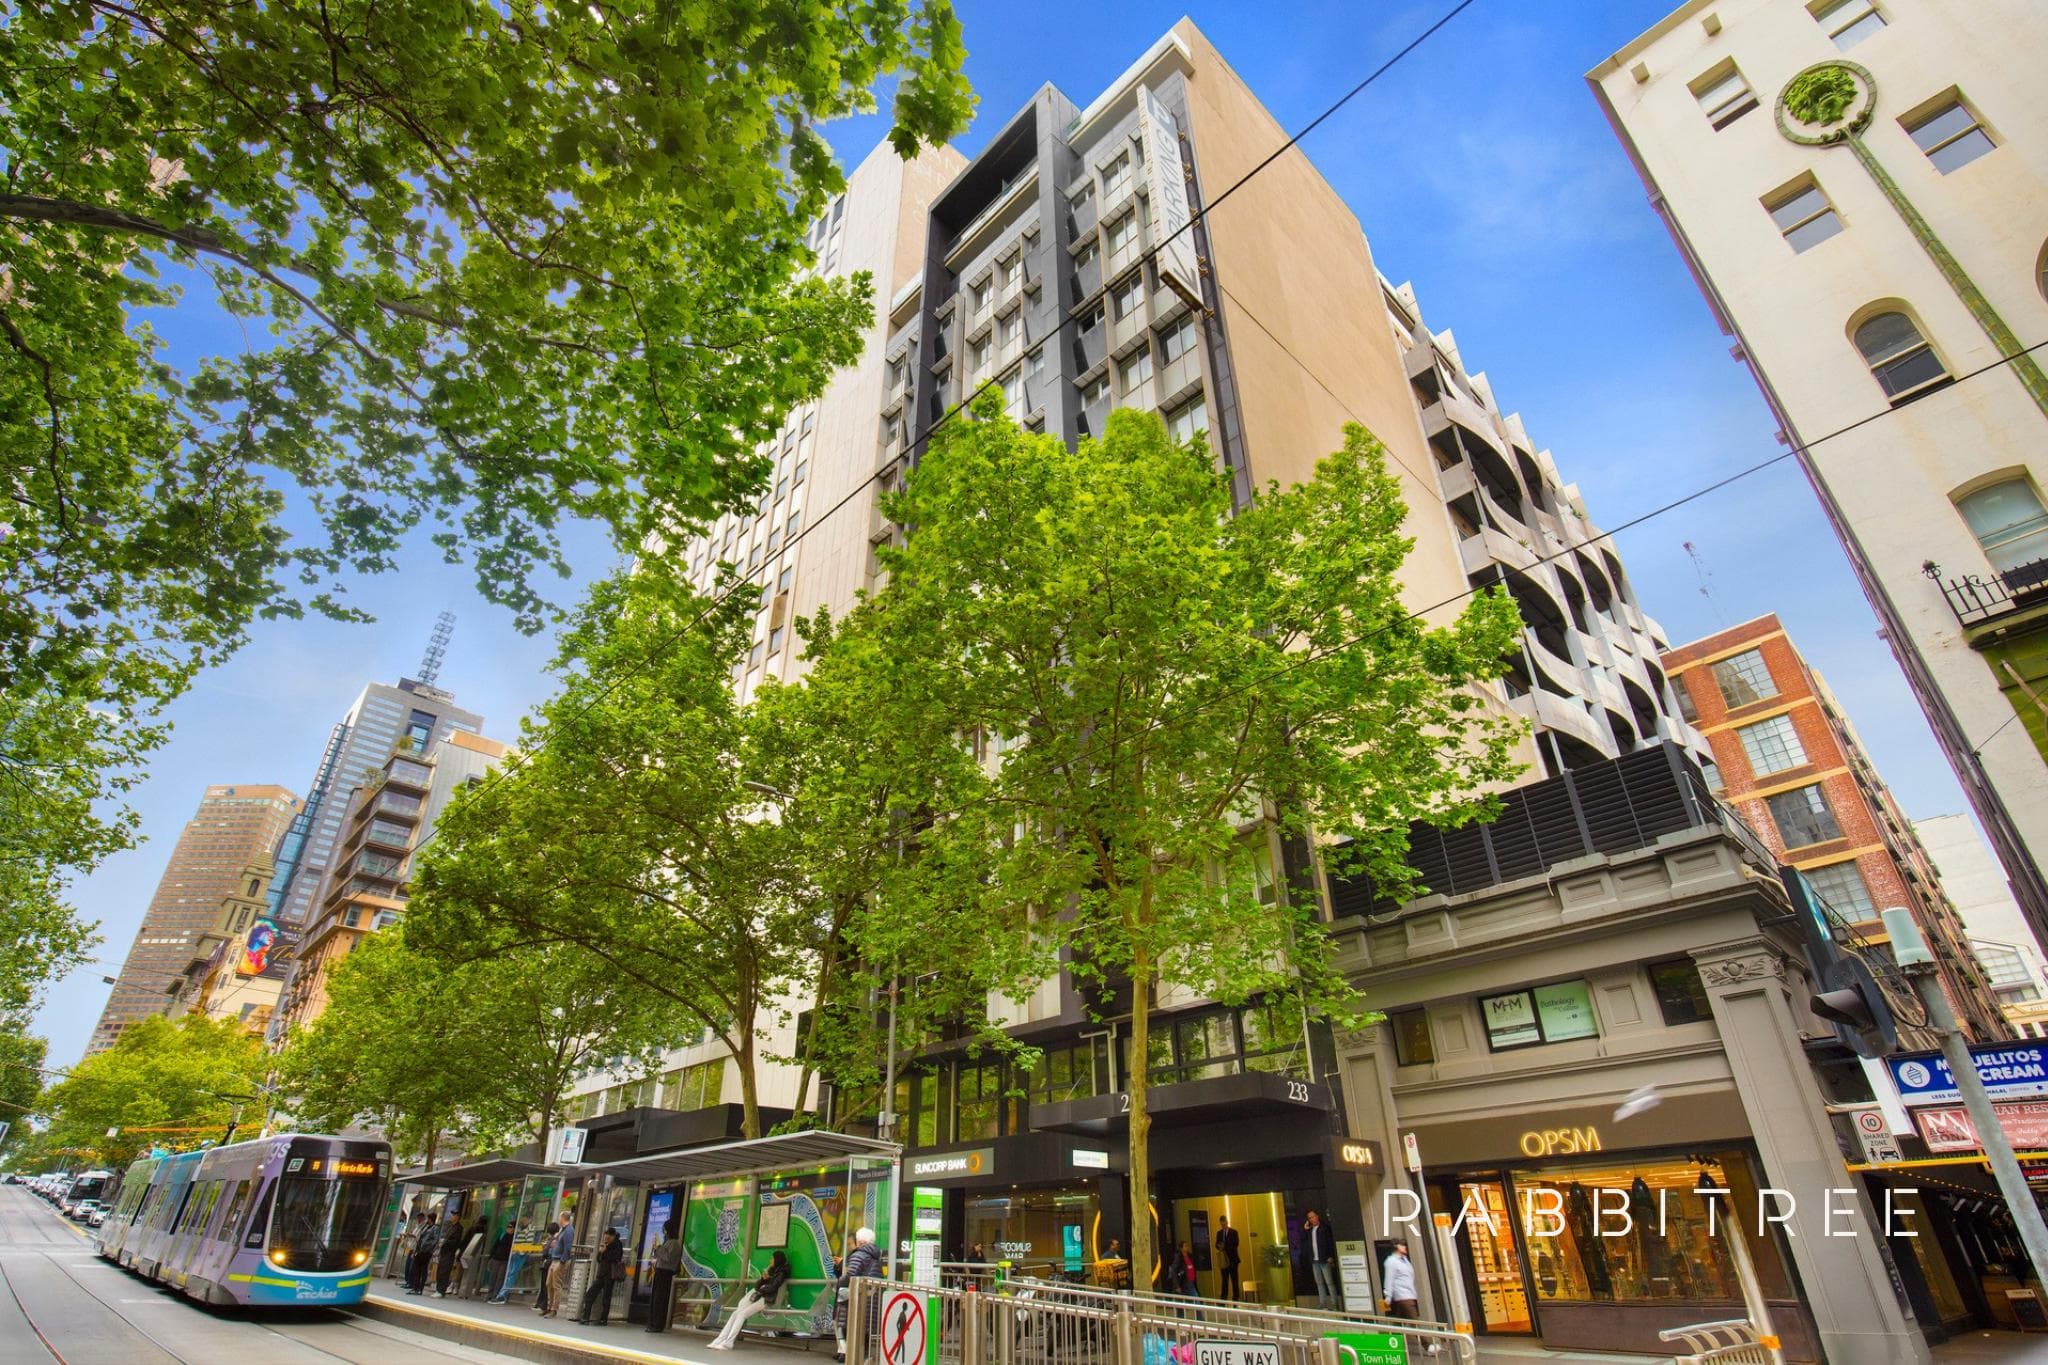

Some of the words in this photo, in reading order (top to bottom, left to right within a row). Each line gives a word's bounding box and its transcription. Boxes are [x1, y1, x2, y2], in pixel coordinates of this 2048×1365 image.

[1156, 128, 1189, 249] PARKING
[1935, 1049, 2042, 1071] MUELITOS
[1978, 1063, 2046, 1082] CREAM
[1287, 1080, 1309, 1102] 233
[1865, 1118, 1877, 1127] 10
[1520, 1126, 1602, 1158] OPSM
[1863, 1132, 1890, 1140] SHARED
[1870, 1139, 1888, 1147] ZONE
[914, 1160, 948, 1175] SUNCORP
[947, 1157, 968, 1171] BANK
[1201, 1351, 1232, 1365] GIVE
[1243, 1352, 1273, 1365] WAY
[1361, 1352, 1384, 1364] Town
[1385, 1353, 1403, 1365] Hall
